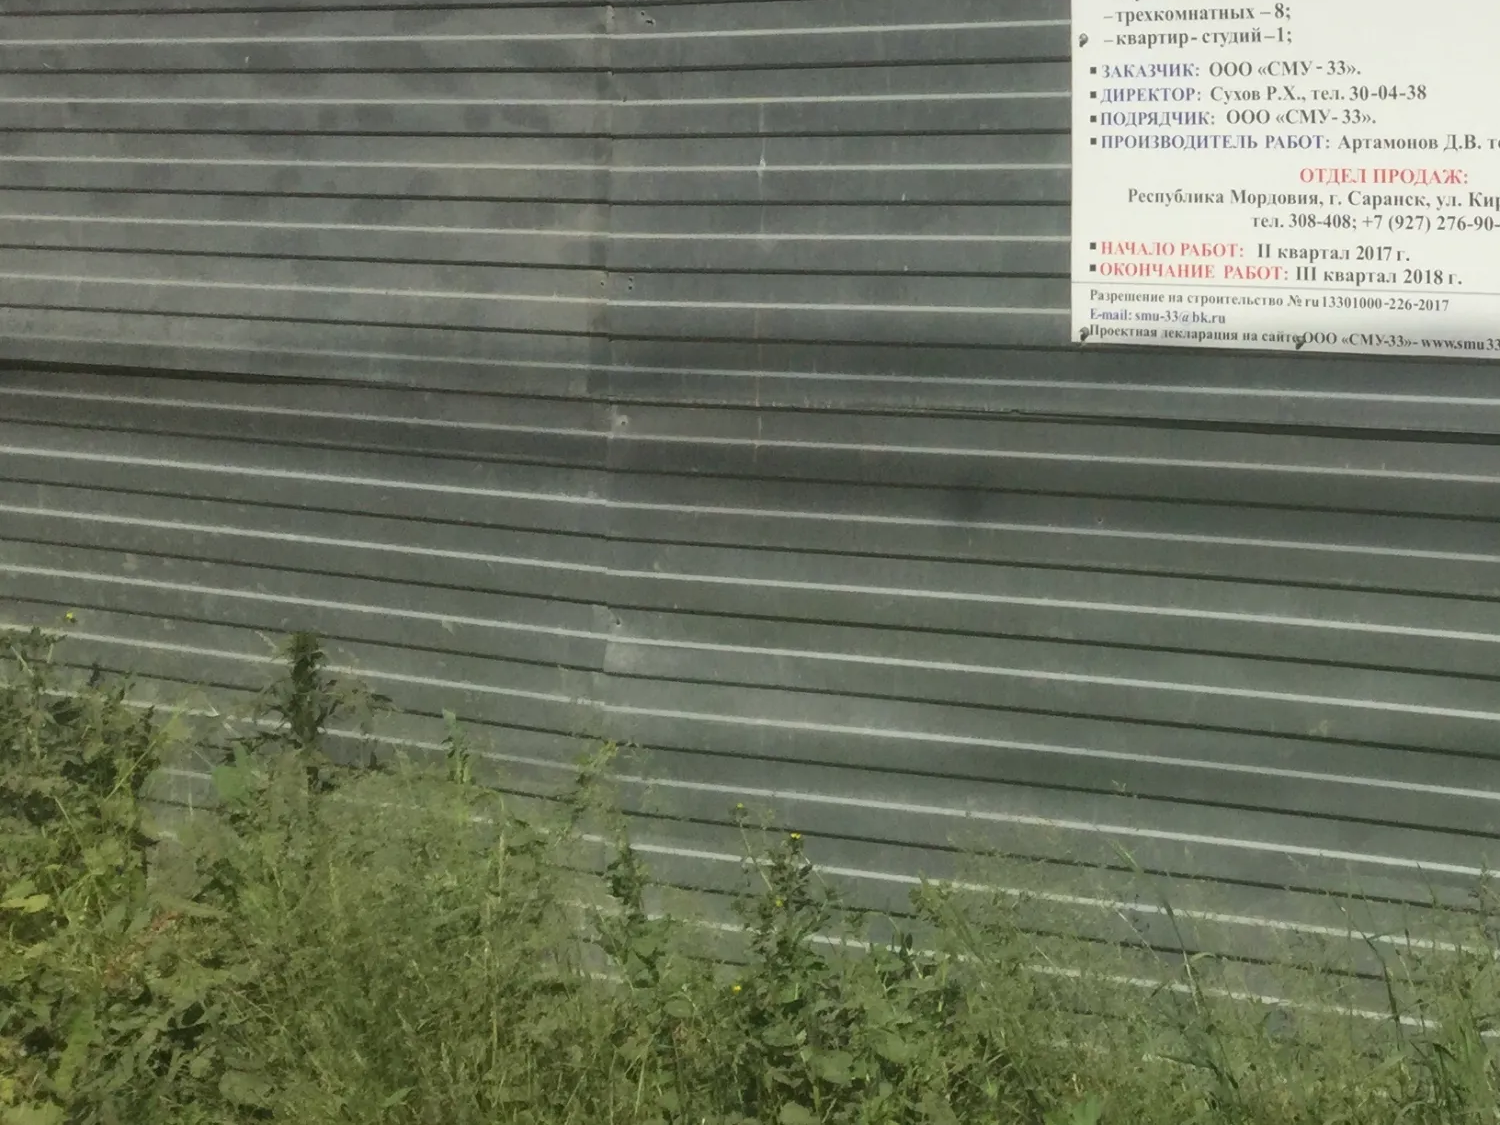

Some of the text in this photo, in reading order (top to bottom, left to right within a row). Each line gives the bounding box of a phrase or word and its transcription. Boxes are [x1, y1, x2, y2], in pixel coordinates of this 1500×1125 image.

[1101, 62, 1200, 79] ЗАКАЗЧИК:
[1208, 61, 1253, 78] ООО
[1099, 84, 1427, 106] ДИРЕКТОР: Сухов Р.Х., тел. 30-04-38
[1100, 110, 1215, 128] ПОДРЯДЧИК:
[1226, 108, 1271, 125] ООО
[1101, 134, 1259, 152] ПРОИЗВОДИТЕЛЬ
[1265, 134, 1330, 150] РАБОТ:
[1337, 134, 1439, 154] Артамонов
[1442, 133, 1482, 152] Д.В.
[1299, 167, 1468, 187] ОТДЕЛ ПРОДАЖ:
[1128, 187, 1225, 208] Республика
[1230, 188, 1324, 209] Мордовия,
[1329, 194, 1342, 206] г.
[1347, 190, 1431, 211] Саранск,
[1435, 195, 1463, 212] ул.
[1252, 216, 1285, 228] тел.
[1288, 212, 1357, 232] 308-408;
[1361, 214, 1383, 230] +7
[1388, 214, 1432, 233] (927)
[1101, 241, 1410, 264] НАЧАЛО РАБОТ: II квартал 2017 г.
[1099, 262, 1463, 287] ОКОНЧАНИЕ РАБОТ: III квартал 2018 г.
[1090, 288, 1165, 305] Разрешение
[1168, 294, 1184, 304] на
[1186, 294, 1284, 308] строительство
[1286, 294, 1303, 308] №
[1304, 298, 1320, 308] ru
[1090, 307, 1226, 324] E-mail: smu-33@bk.ru
[1090, 323, 1158, 339] Проектная
[1242, 332, 1258, 342] на
[1303, 331, 1338, 345] ООО
